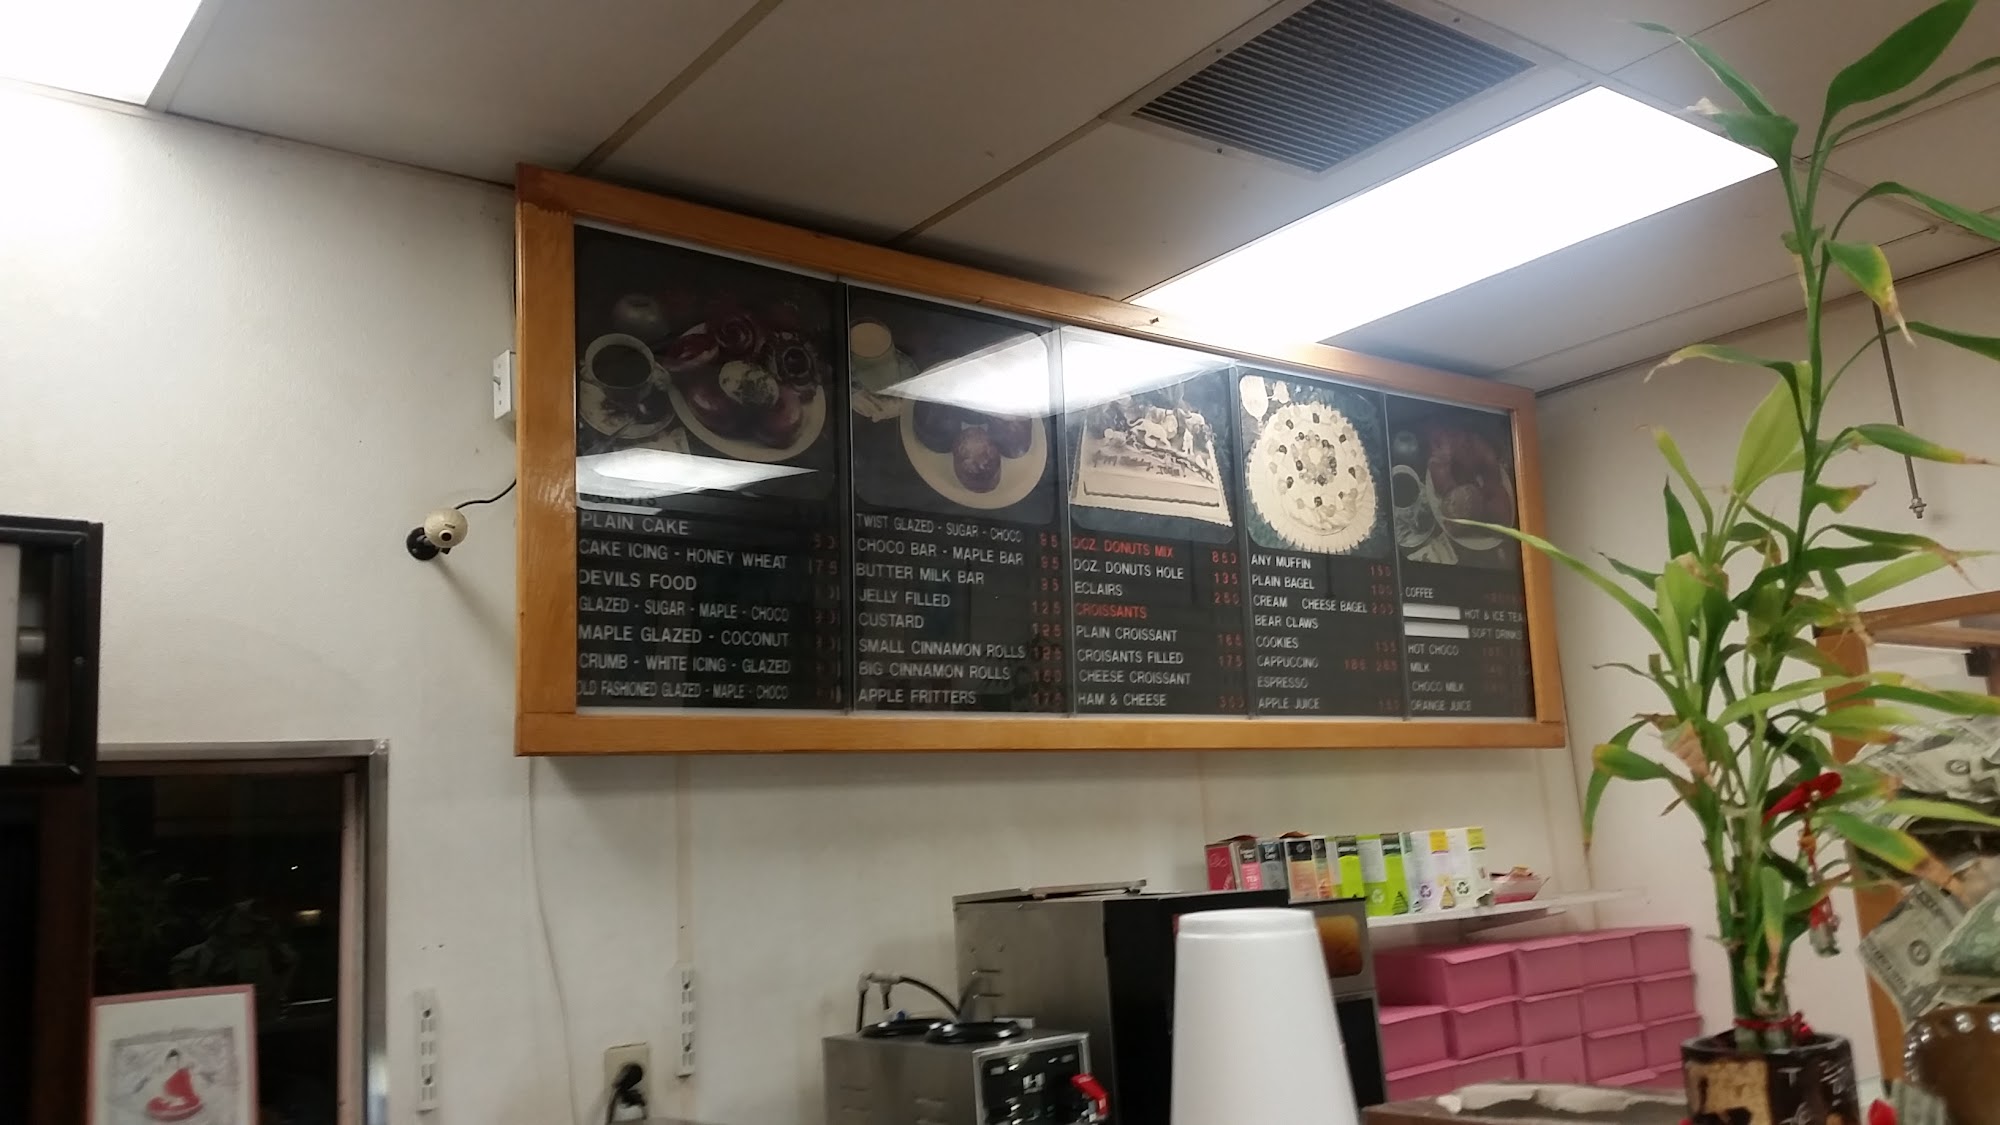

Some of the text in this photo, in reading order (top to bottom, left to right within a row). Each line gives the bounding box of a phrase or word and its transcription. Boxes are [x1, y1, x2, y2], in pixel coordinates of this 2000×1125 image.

[581, 513, 689, 535] PLAIN CAKE
[856, 513, 888, 529] TWIST
[894, 517, 933, 533] GLAZED
[946, 522, 978, 537] SUGAR
[990, 527, 1022, 543] CHOCO
[579, 539, 622, 557] CAKE
[629, 543, 668, 560] ICING
[686, 548, 734, 565] HONEY
[742, 552, 787, 569] WHEAT
[857, 538, 904, 554] CHOCO
[911, 543, 937, 557] BAR
[953, 547, 994, 563] MAPLE
[1000, 551, 1023, 565] BAR
[1104, 540, 1150, 556] DONUTS
[1155, 545, 1174, 558] MIX
[1251, 554, 1311, 569] ANY MUFFIN
[856, 563, 984, 585] BUTTER MILK BAR
[1106, 562, 1151, 577] DONUTS
[1156, 566, 1183, 580] HOLE
[578, 569, 697, 591] DEVILS FOOD
[1252, 575, 1315, 590] PLAIN BAGEL
[1075, 582, 1123, 596] ECLAIRS
[1405, 587, 1434, 598] COFFEE
[859, 589, 950, 607] JELLY FILLED
[1253, 595, 1368, 613] CREAM CHEESE BAGEL
[579, 596, 629, 613] GLAZED
[644, 599, 685, 616] SUGAR
[700, 603, 737, 619] MAPLE
[751, 606, 789, 622] CHOCO
[1075, 603, 1147, 619] CROISSANTS
[1464, 610, 1480, 619] HOT
[858, 613, 924, 629] CUSTARD
[1255, 615, 1318, 629] BEAR CLAWS
[578, 625, 633, 641] MAPLE
[640, 627, 702, 644] GLAZED
[721, 630, 789, 647] COCONUT
[1076, 625, 1177, 642] PLAIN CROISSANT
[859, 639, 904, 654] SMALL
[911, 640, 981, 657] CINNAMON
[986, 644, 1025, 659] ROLLS
[1256, 636, 1298, 649] COOKIES
[1408, 644, 1459, 656] HOT CHOCO
[579, 653, 628, 669] CRUMB
[645, 655, 687, 671] WHITE
[693, 657, 726, 672] ICING
[742, 658, 791, 674] GLAZED
[1148, 651, 1183, 664] FILLED
[1257, 656, 1319, 668] CAPPUCCINO
[859, 662, 1010, 680] BIG CINNAMON ROLLS
[1410, 662, 1430, 672] MILK
[1079, 670, 1192, 685] CHEESE CROISSANT
[1258, 676, 1309, 688] ESPRESSO
[601, 680, 657, 697] FASHIONED
[661, 682, 700, 698] GLAZED
[713, 684, 744, 698] MAPLE
[756, 685, 788, 700] CHOCO
[858, 689, 903, 703] APPLE
[910, 690, 976, 704] FRITTERS
[1078, 693, 1167, 706] HAM & CHEESE
[1258, 698, 1320, 709] APPLE JUICE
